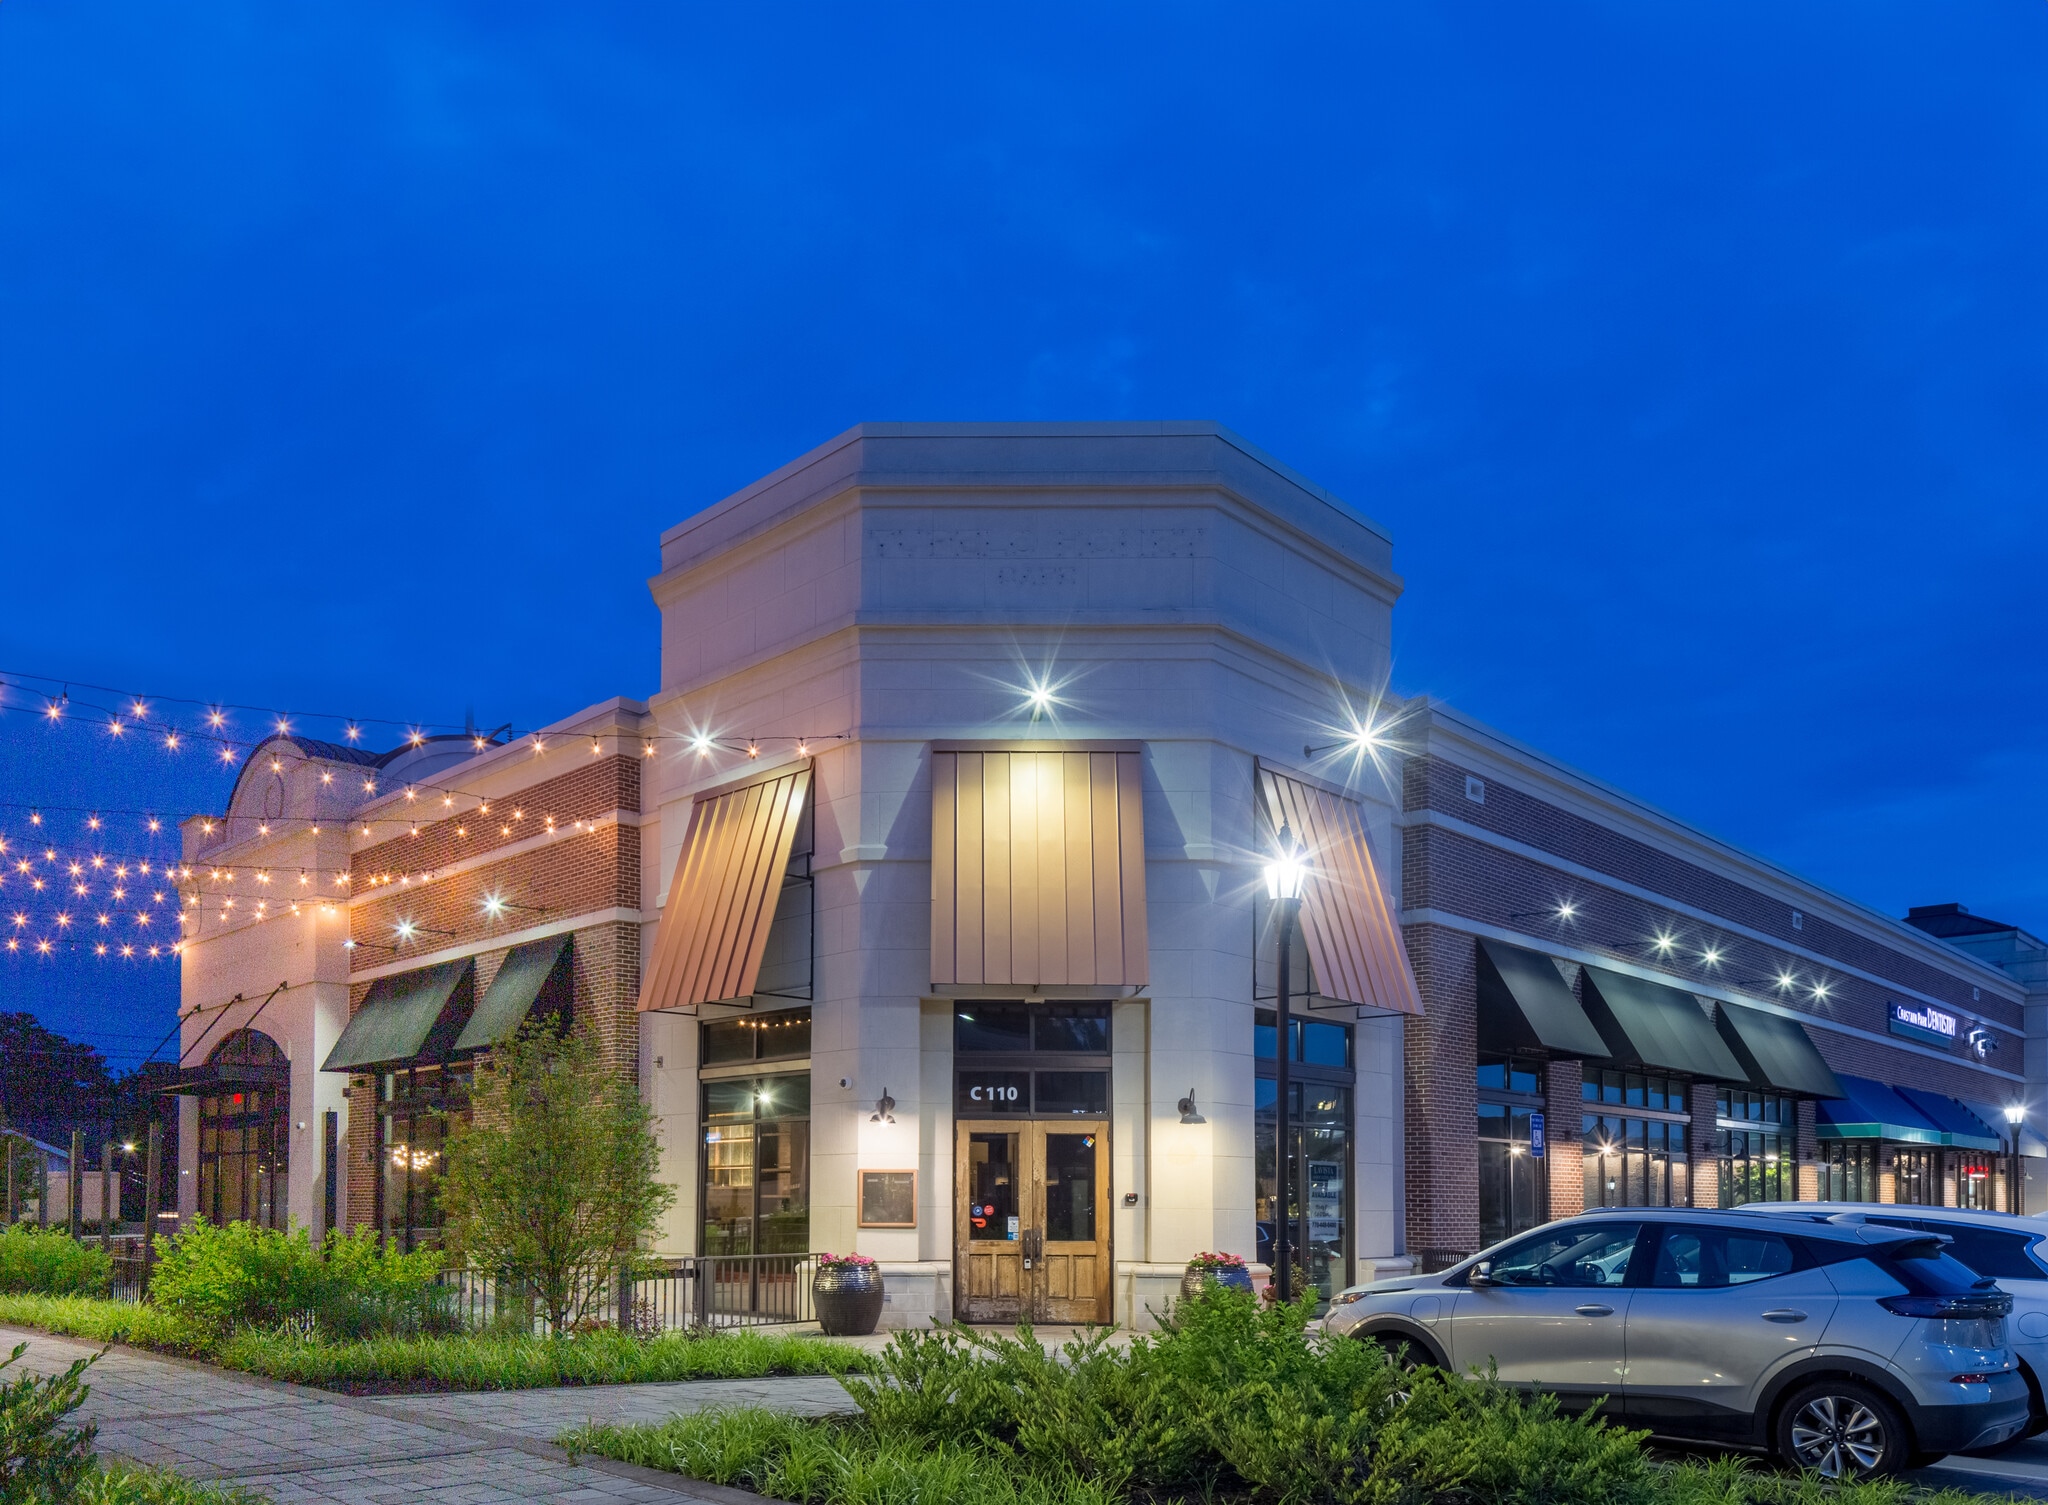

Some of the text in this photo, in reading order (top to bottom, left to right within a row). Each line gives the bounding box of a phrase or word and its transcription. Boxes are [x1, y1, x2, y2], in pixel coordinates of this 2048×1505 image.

[1927, 1007, 1956, 1037] DENTISTRY
[970, 1086, 1018, 1101] C 110
